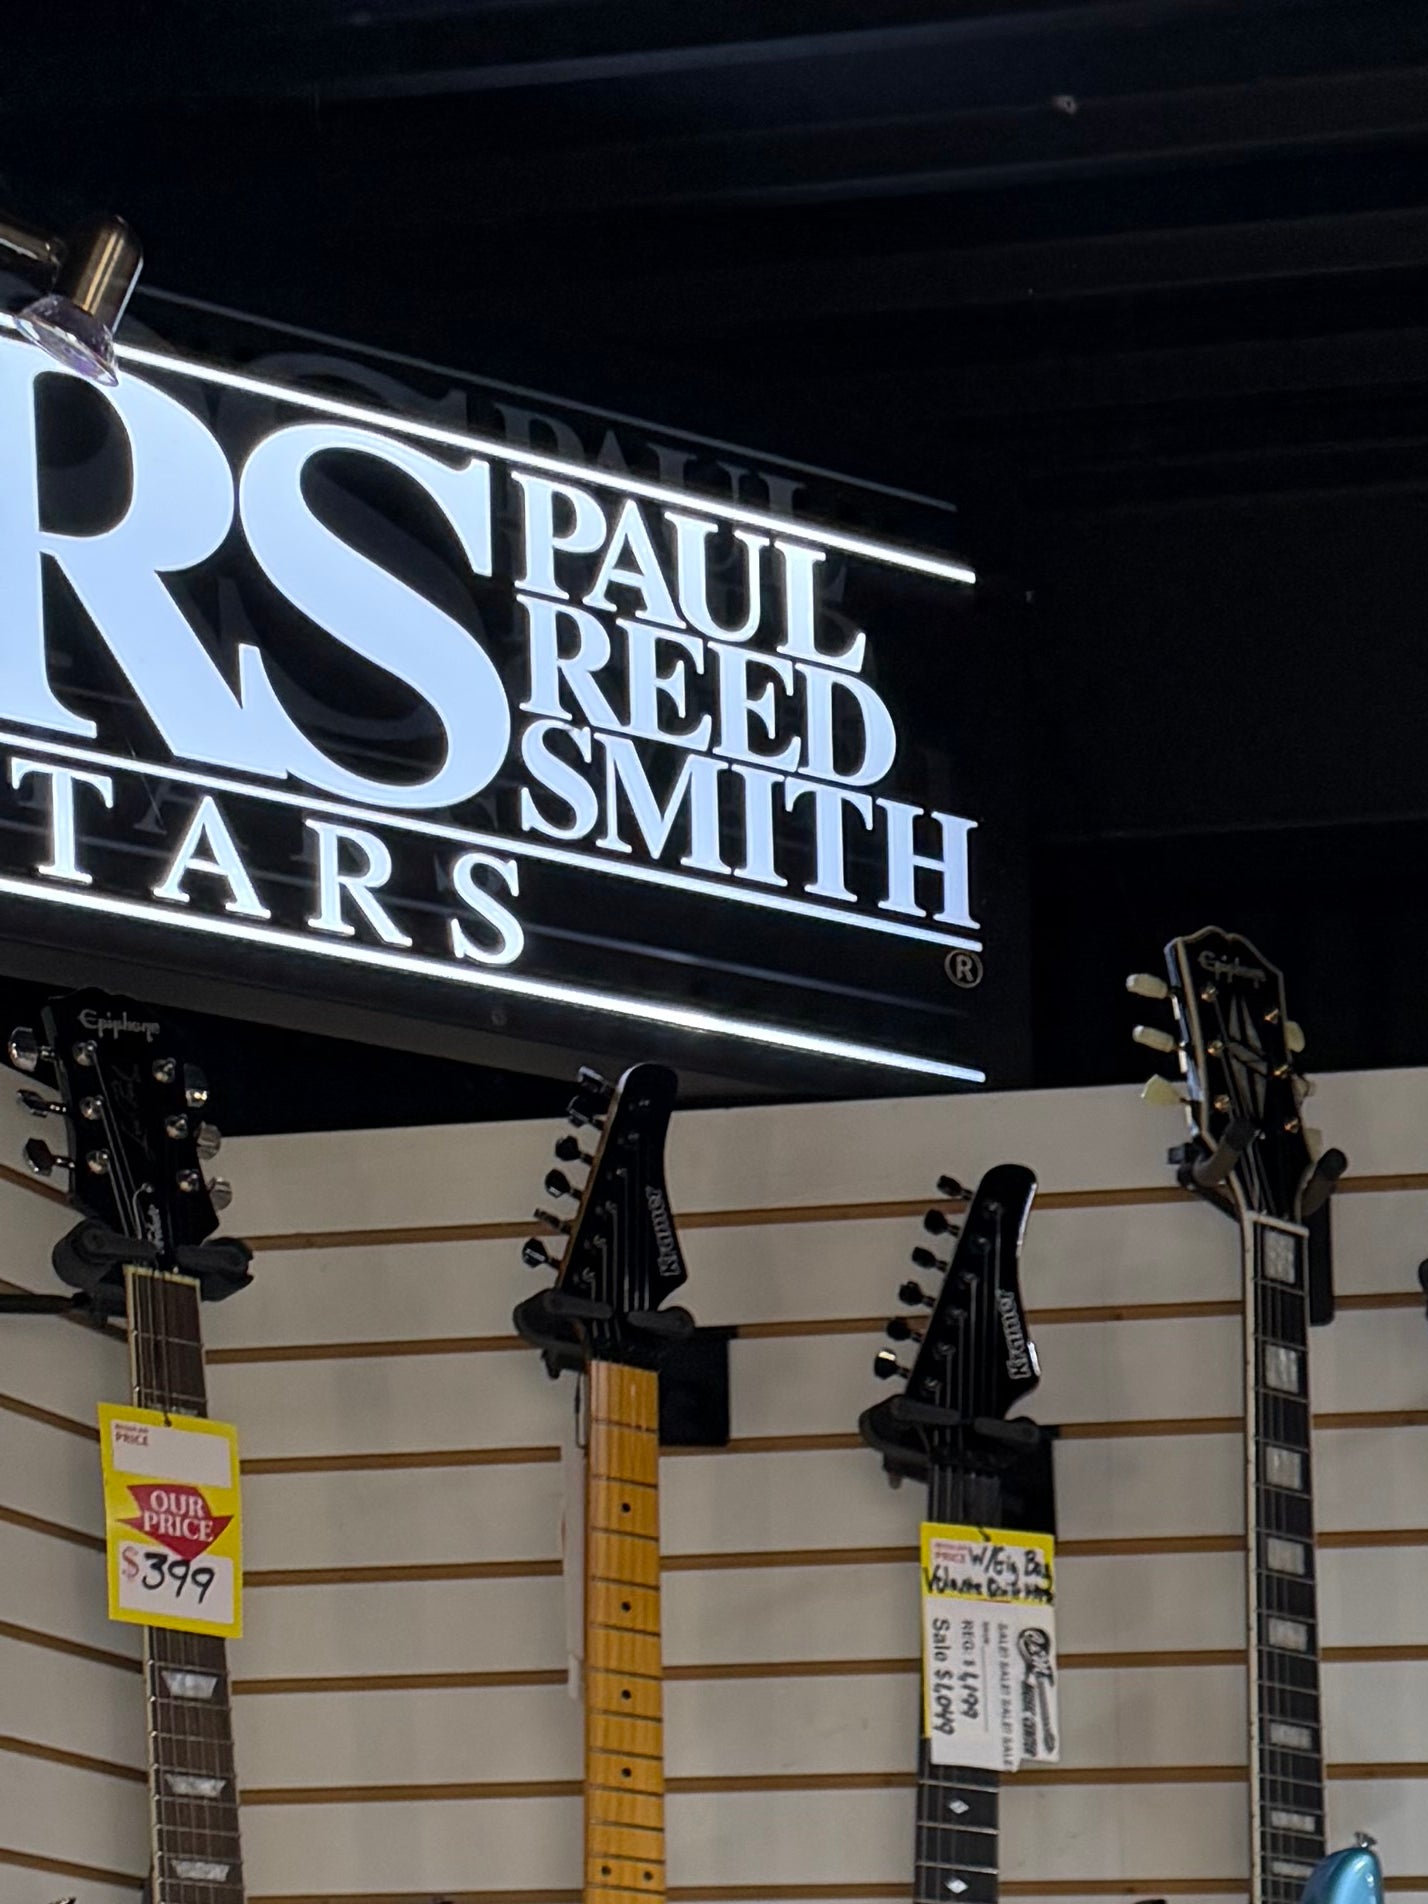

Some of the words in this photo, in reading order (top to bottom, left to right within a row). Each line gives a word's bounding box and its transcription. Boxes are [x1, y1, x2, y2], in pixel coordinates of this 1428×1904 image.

[513, 471, 864, 672] PAUL
[517, 595, 895, 787] REED
[10, 757, 524, 965] TARS
[521, 720, 980, 928] SMITH
[79, 1009, 161, 1043] Epiphone
[142, 1511, 215, 1543] PRICE
[149, 1490, 204, 1519] OUR
[121, 1546, 215, 1605] $399
